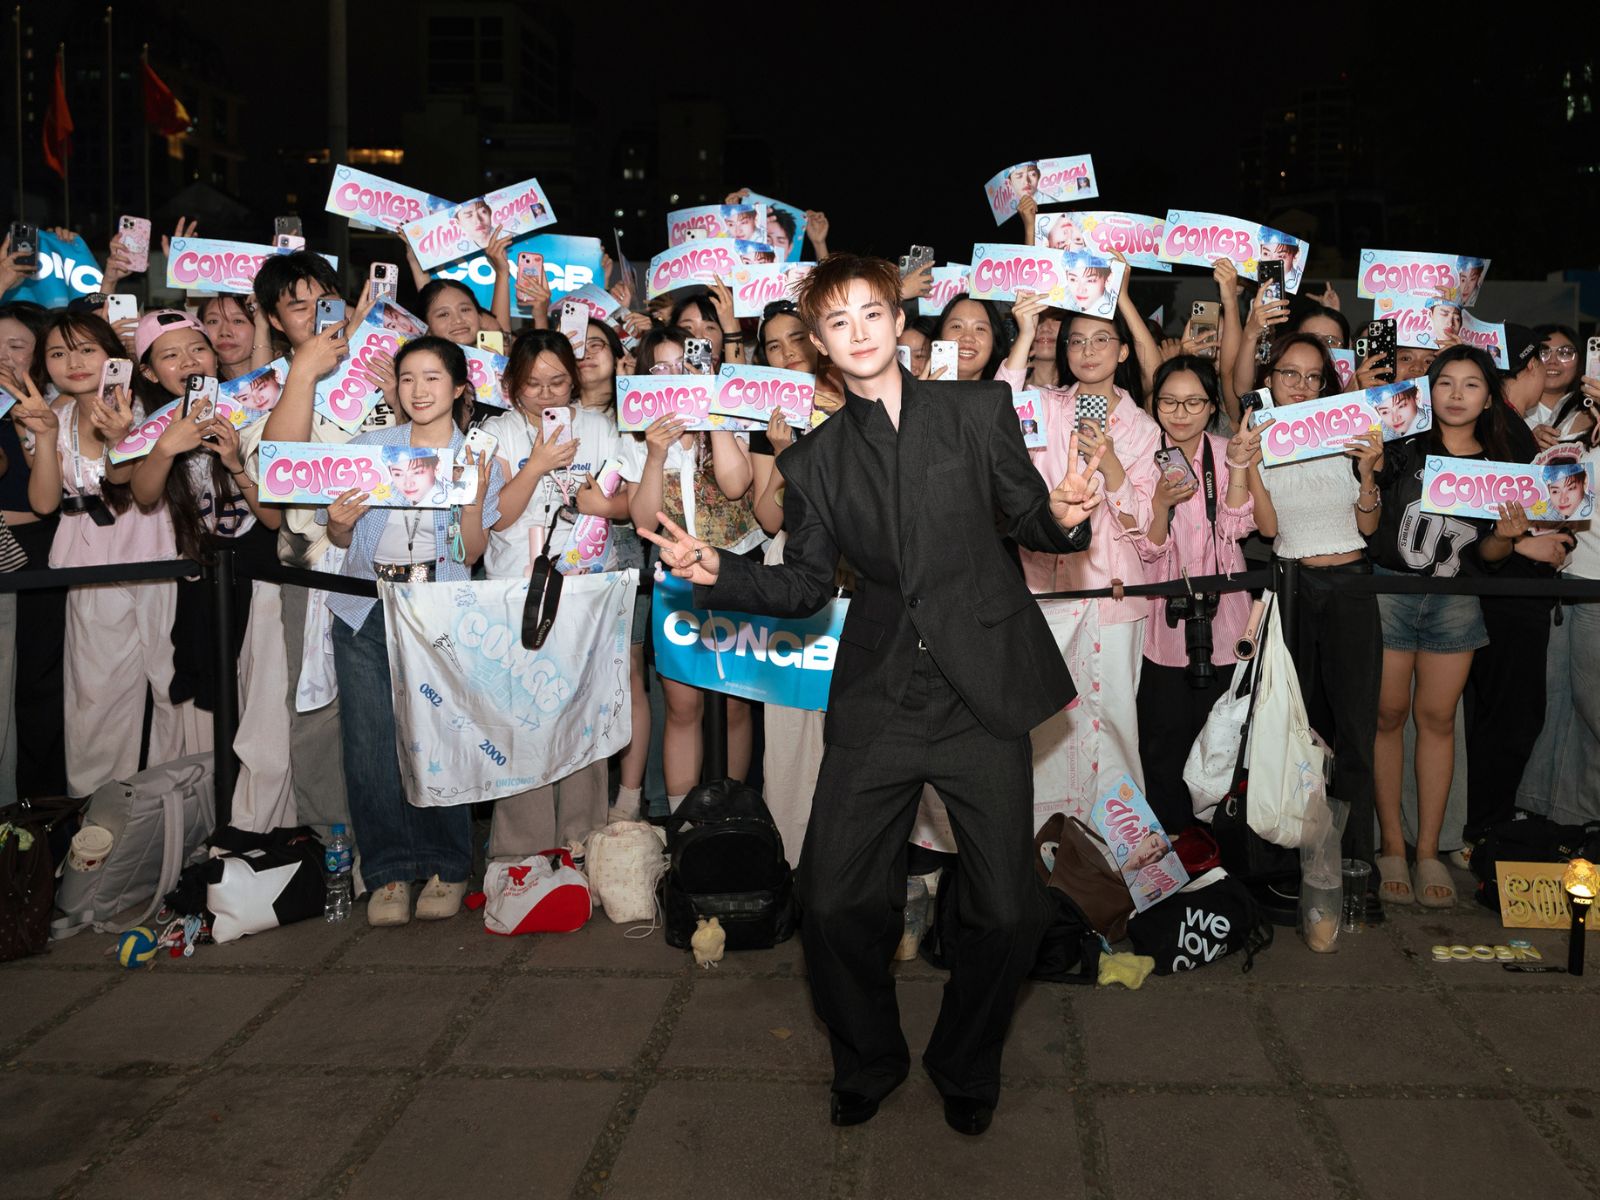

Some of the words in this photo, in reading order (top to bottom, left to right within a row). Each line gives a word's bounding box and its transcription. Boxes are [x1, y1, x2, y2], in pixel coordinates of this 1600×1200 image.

[335, 182, 424, 221] CONGB
[1166, 225, 1254, 262] CONGB
[653, 247, 736, 290] CONGB
[974, 257, 1059, 293] CONGB
[1364, 263, 1455, 294] CONGB
[622, 386, 712, 425] CONGB
[719, 377, 814, 417] CONGB
[1267, 404, 1372, 457] CONGB
[265, 456, 381, 496] CONGB
[1205, 471, 1214, 499] Canon
[1429, 472, 1541, 508] CONGB
[663, 609, 840, 671] CONGB
[419, 683, 443, 707] 0812
[478, 738, 507, 767] 2000
[1186, 906, 1231, 939] we
